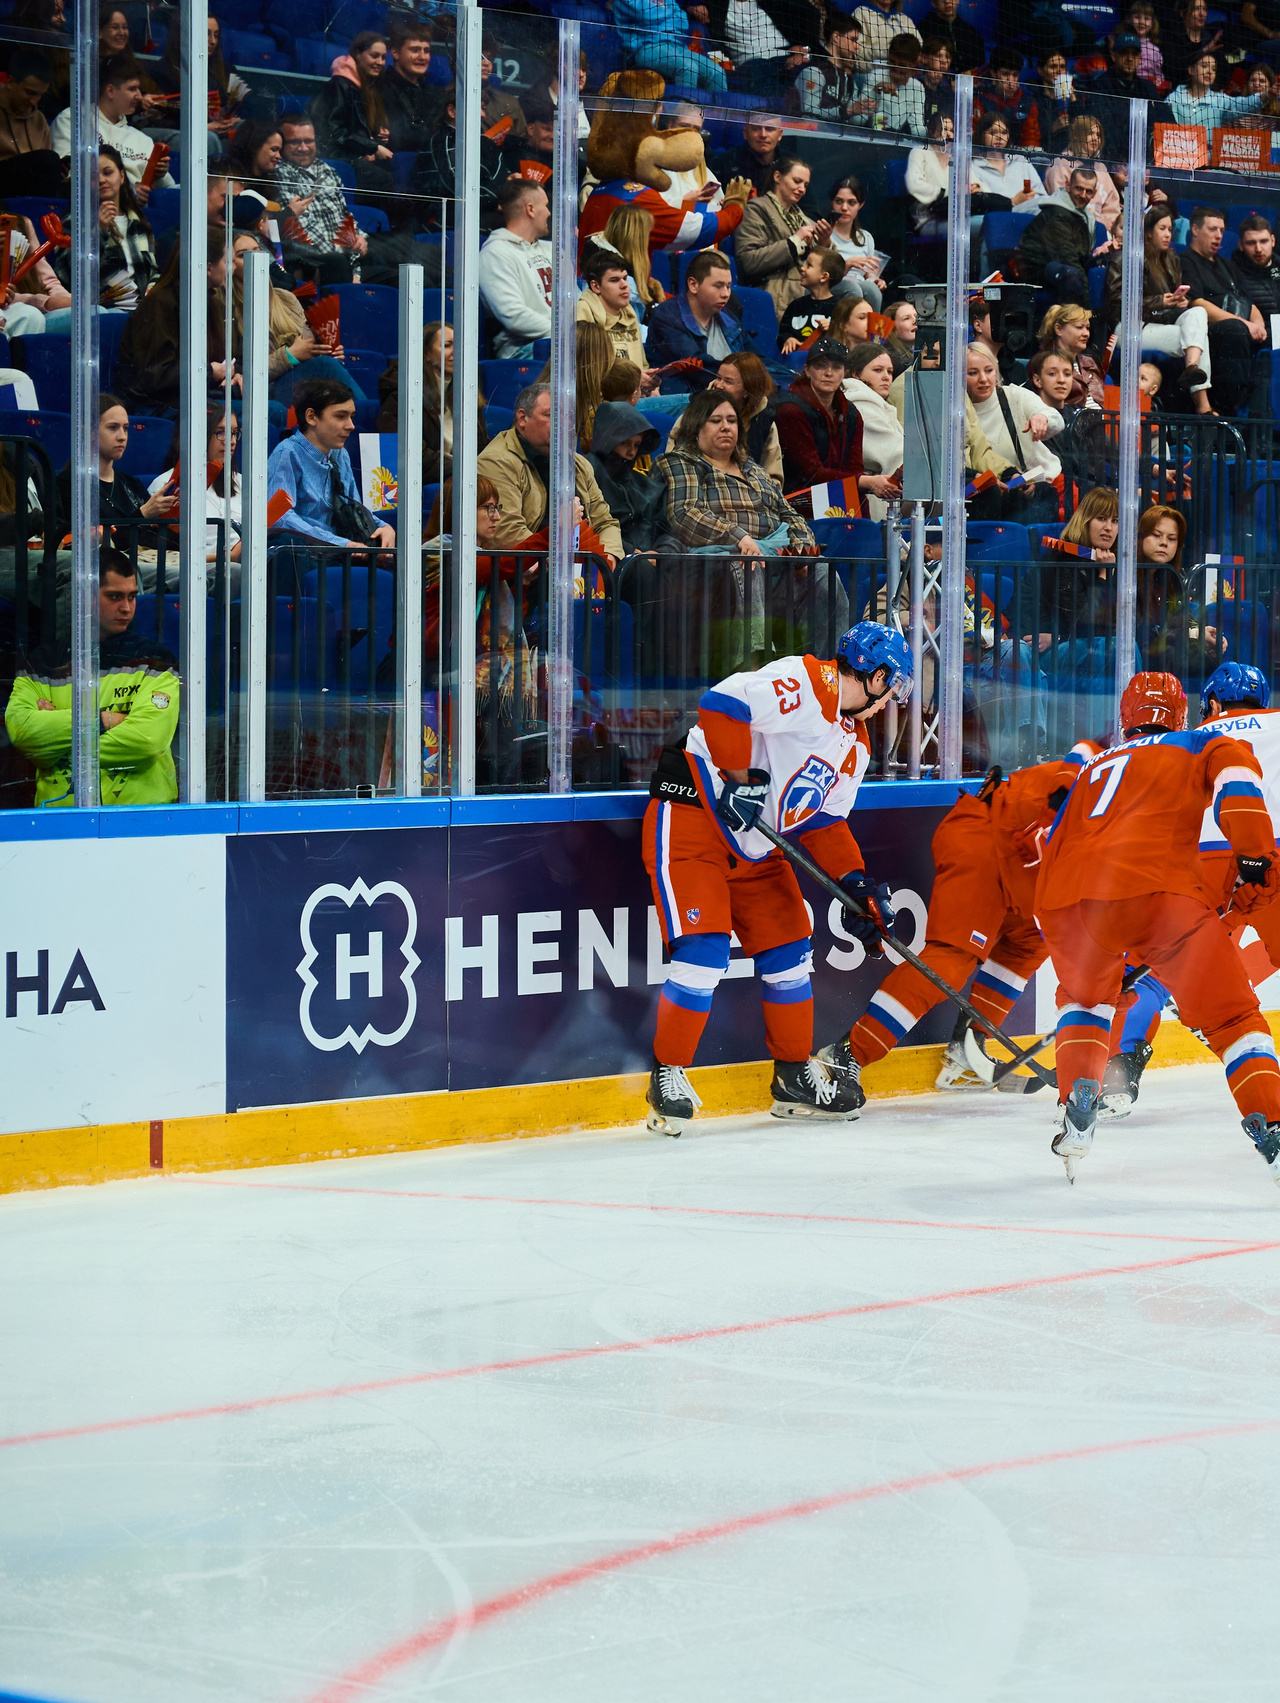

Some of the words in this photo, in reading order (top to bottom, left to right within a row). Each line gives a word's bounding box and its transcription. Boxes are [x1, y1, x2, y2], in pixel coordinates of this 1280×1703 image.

[772, 677, 801, 715] 23
[1150, 708, 1159, 723] 7
[840, 744, 858, 778] A
[1089, 753, 1132, 819] 7
[336, 931, 384, 1001] H
